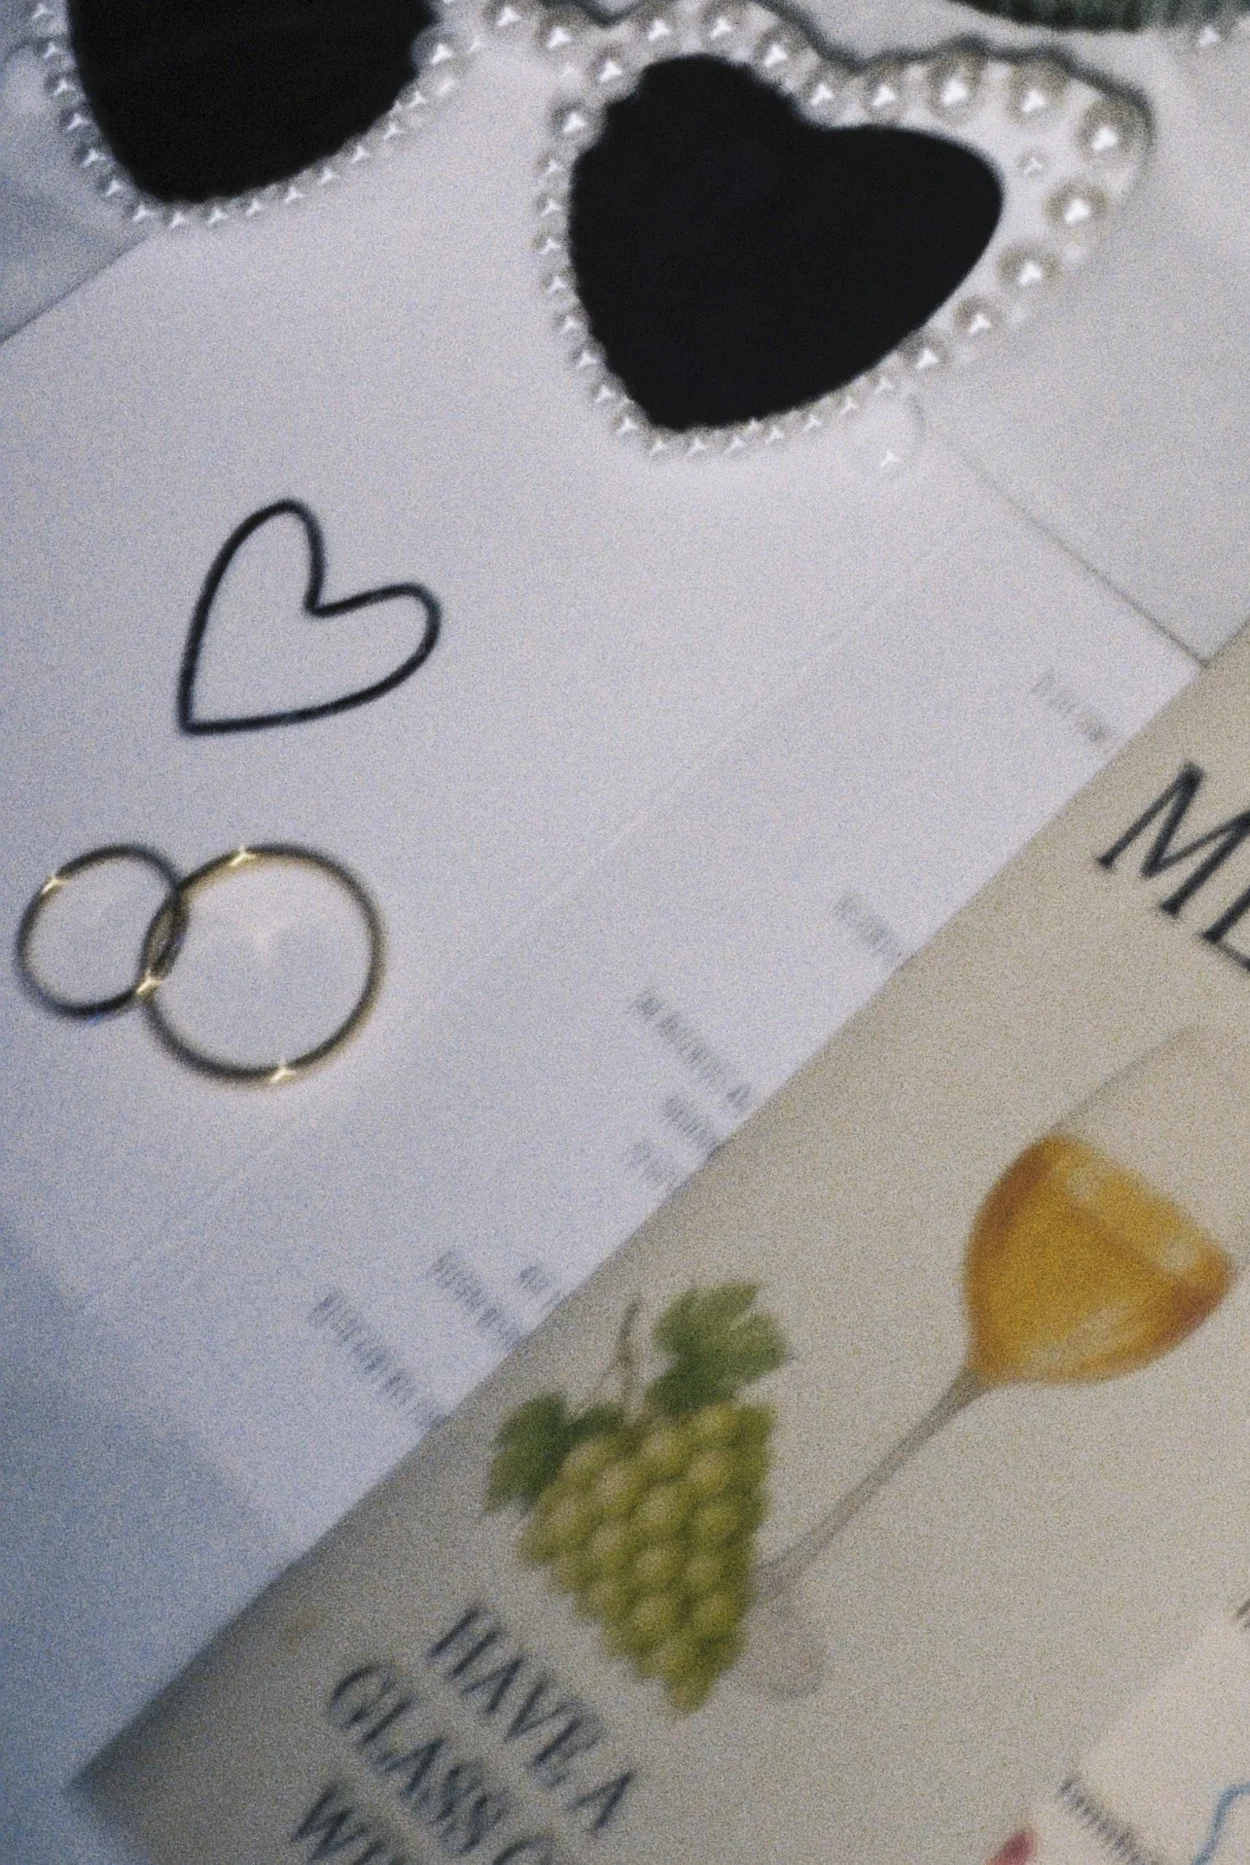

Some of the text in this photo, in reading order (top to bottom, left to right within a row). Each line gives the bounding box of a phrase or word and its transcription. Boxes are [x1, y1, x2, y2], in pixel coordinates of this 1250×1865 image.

[329, 1662, 510, 1855] GLASS
[427, 1605, 604, 1787] HAVE
[567, 1768, 636, 1839] A
